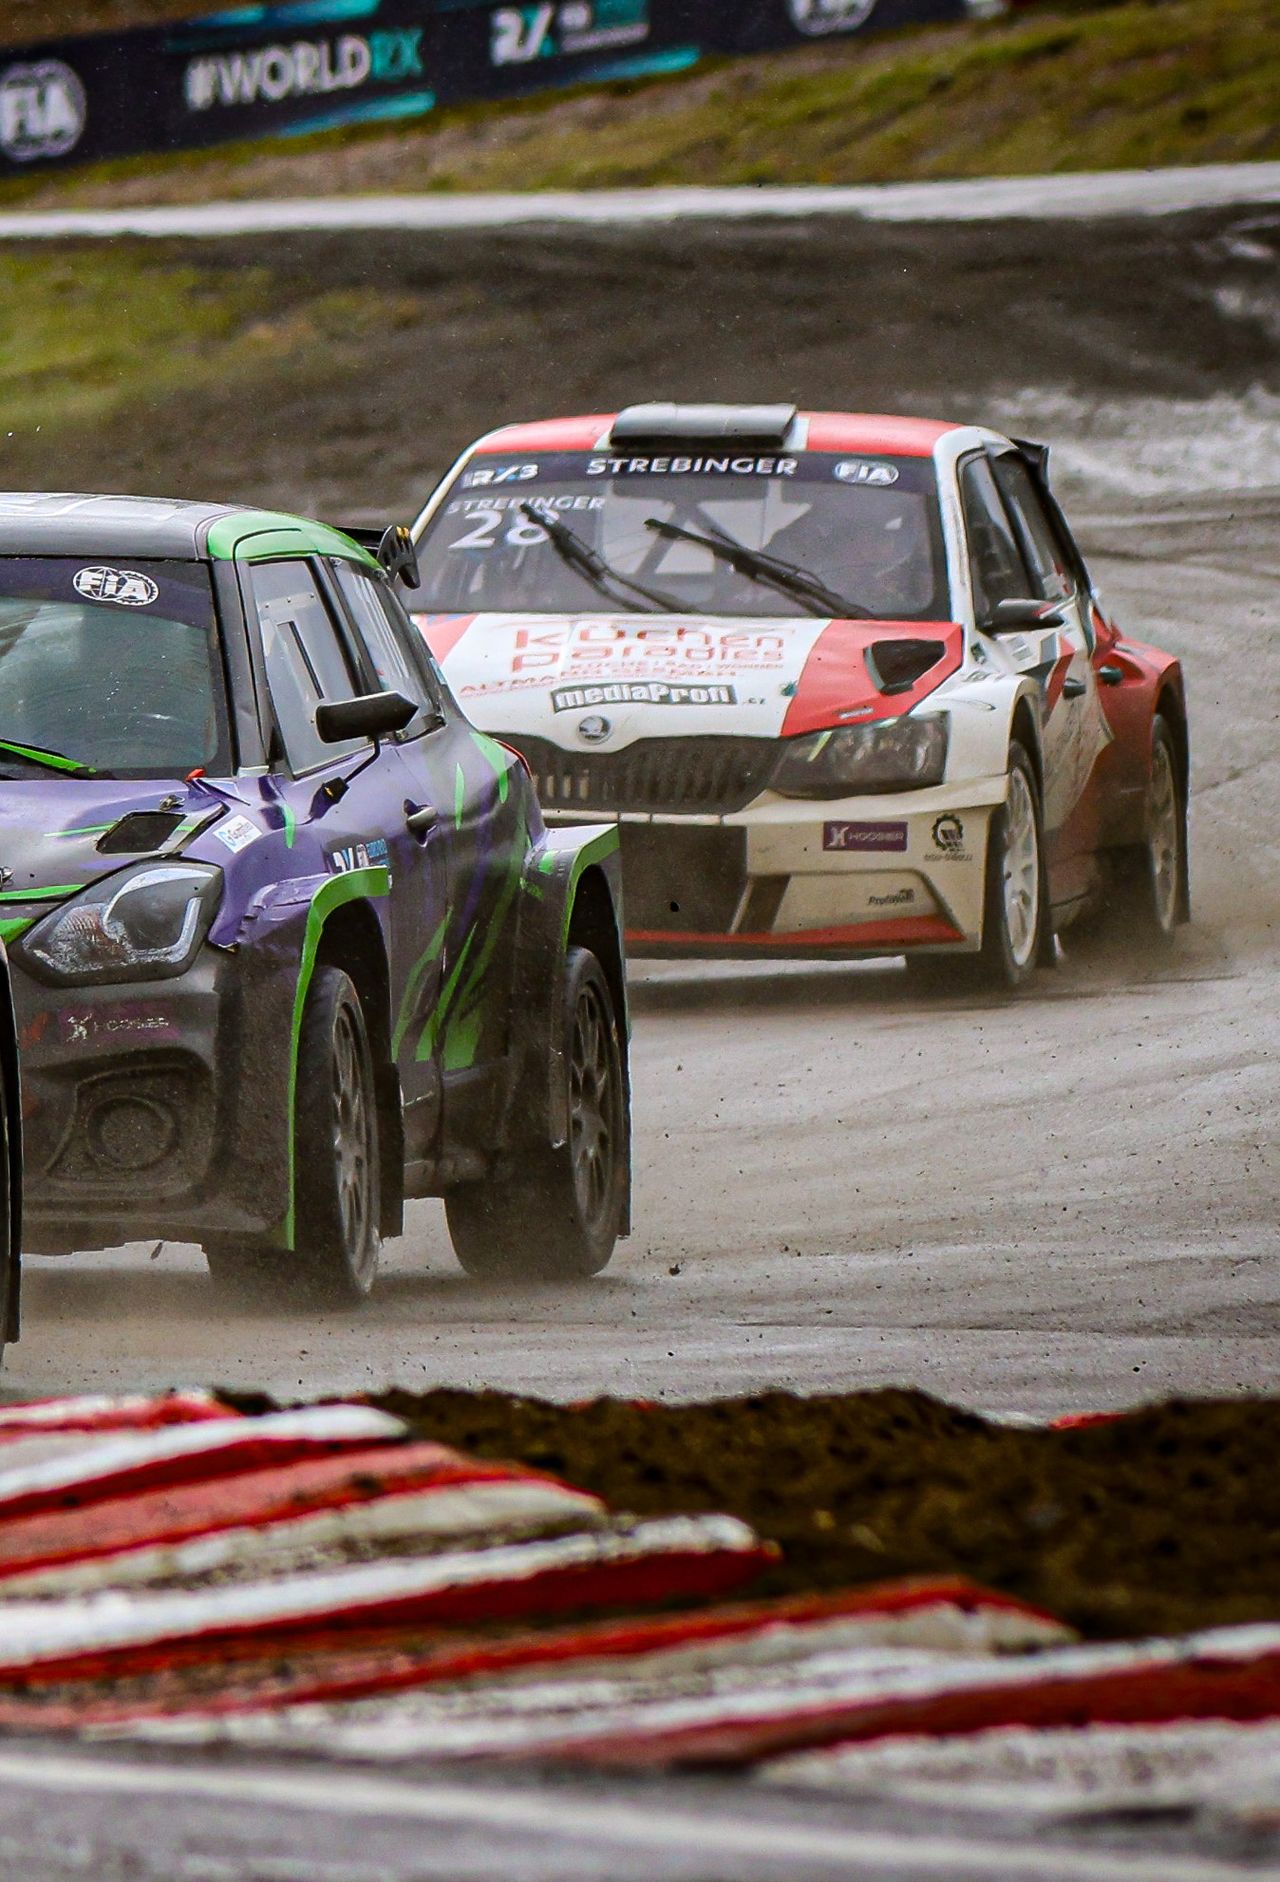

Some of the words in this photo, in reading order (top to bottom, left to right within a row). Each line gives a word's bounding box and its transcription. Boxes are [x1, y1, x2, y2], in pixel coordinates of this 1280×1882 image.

[586, 457, 798, 476] STREBINGER
[837, 462, 894, 485] FIA
[76, 568, 154, 603] FIA
